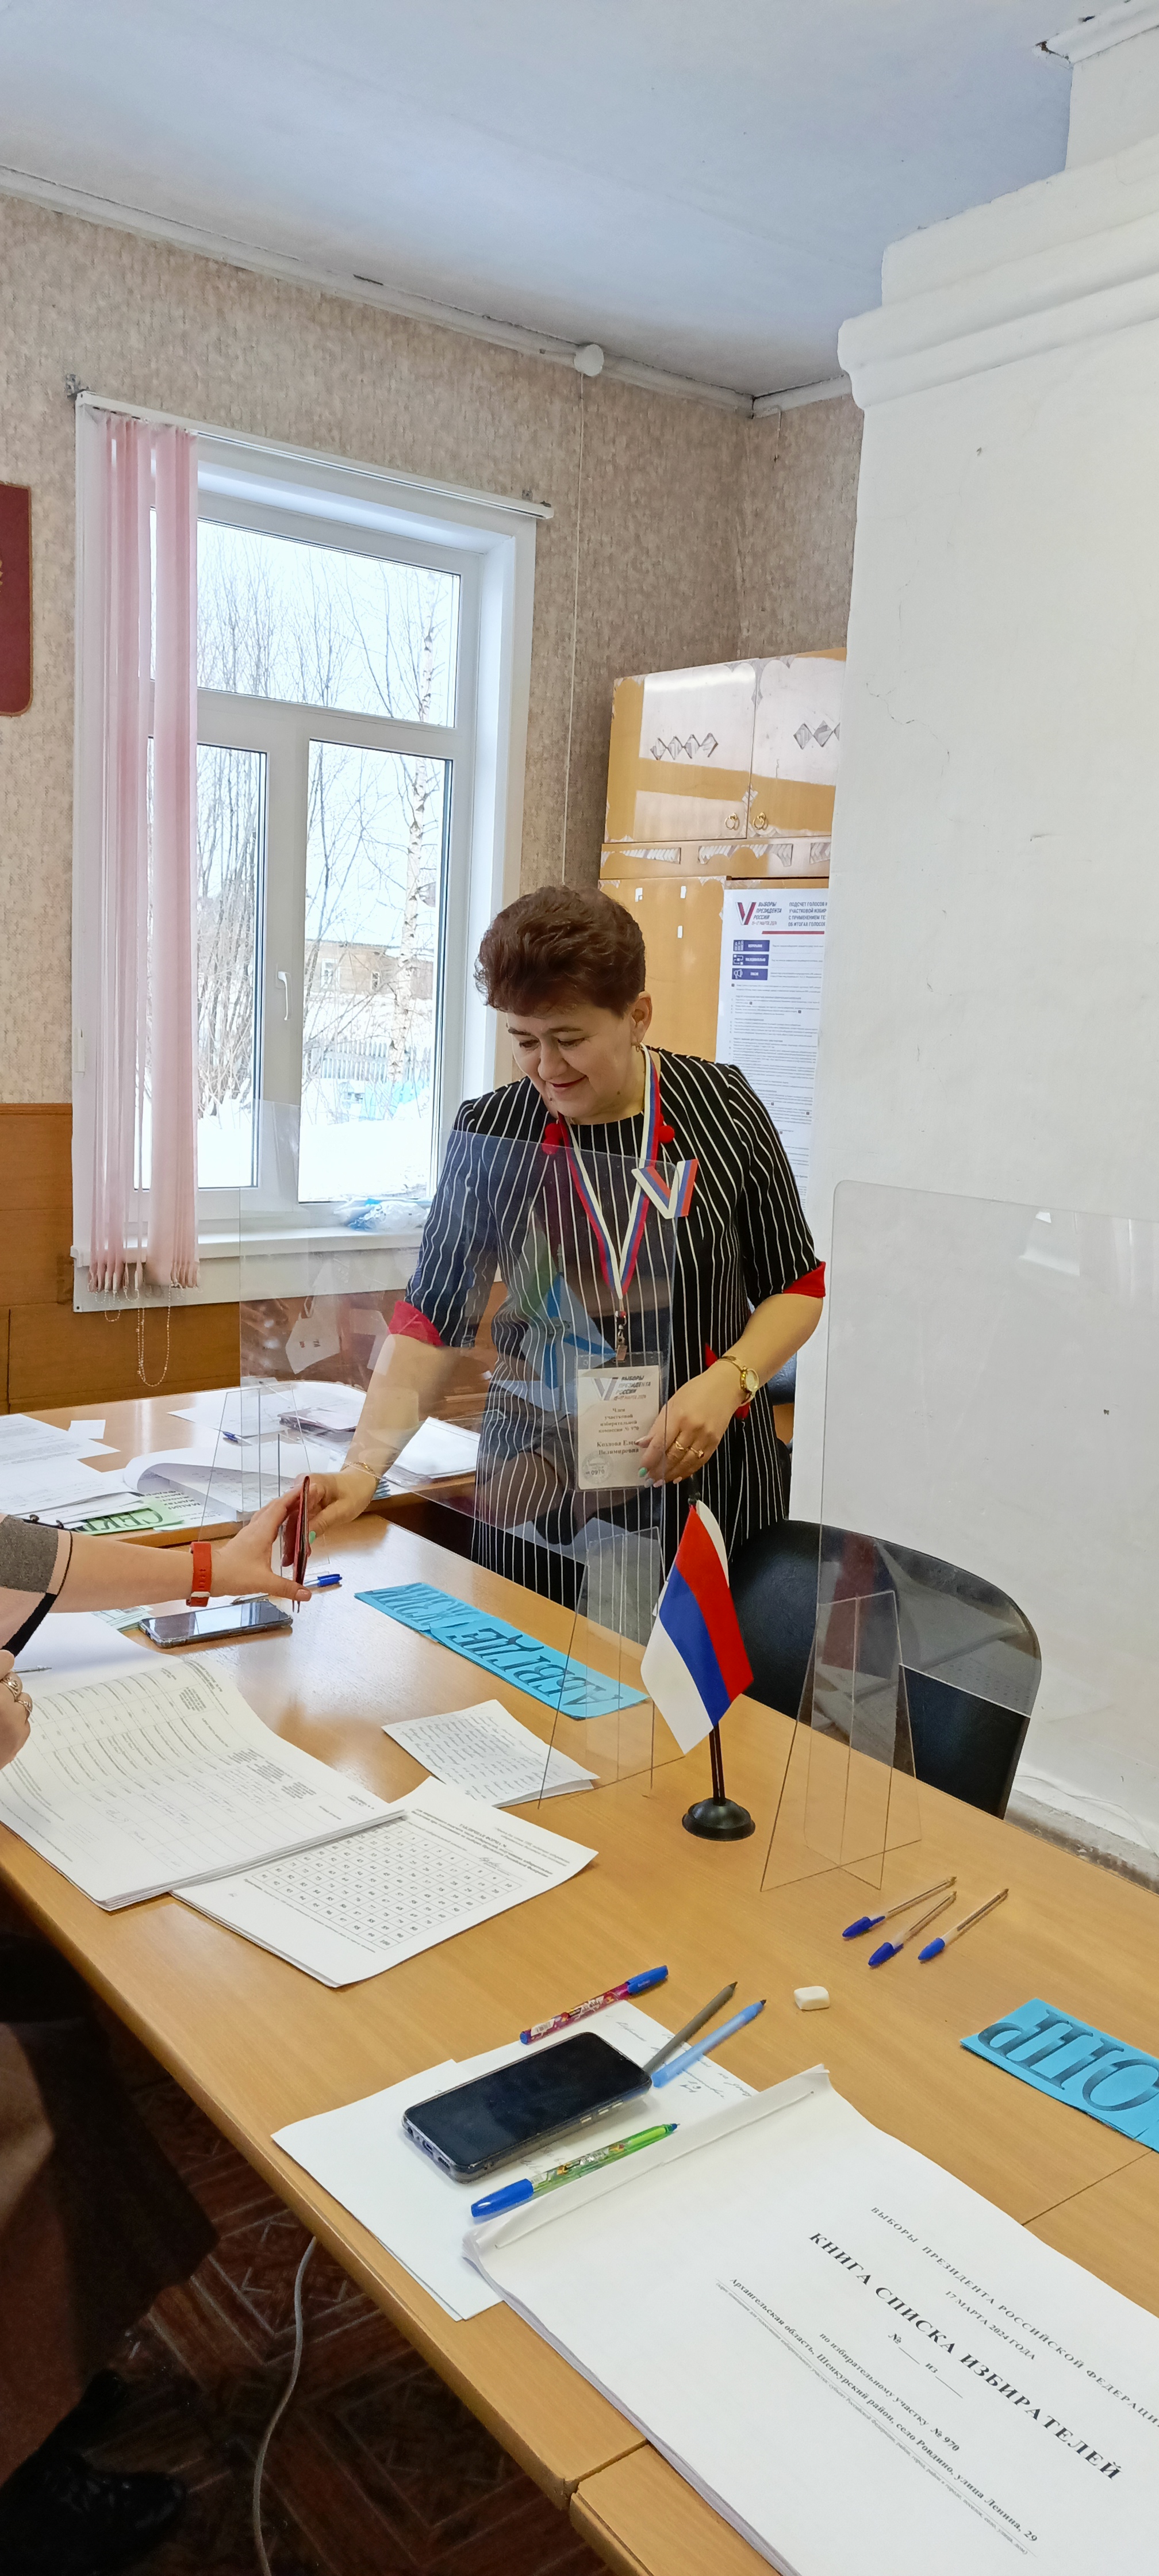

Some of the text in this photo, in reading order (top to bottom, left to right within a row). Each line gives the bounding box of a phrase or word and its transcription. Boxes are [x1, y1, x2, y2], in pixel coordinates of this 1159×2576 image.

[808, 2232, 1122, 2481] КНИГА СПИСКА ИЗБИРАТЕЛЕЙ
[819, 2333, 960, 2452] по избирательному участку № 970
[870, 2207, 1159, 2427] ВЫБОРЫ ПРЕЗИДЕНТА РОССИЙСКОЙ ФЕДЕРАЦИ
[924, 2362, 938, 2375] из
[945, 2290, 1035, 2360] 17 МАРТА 2024 ГОДА
[730, 2278, 1038, 2542] Архангельская область, Шенкурский район, село Ровдино, улица Ленина, 29
